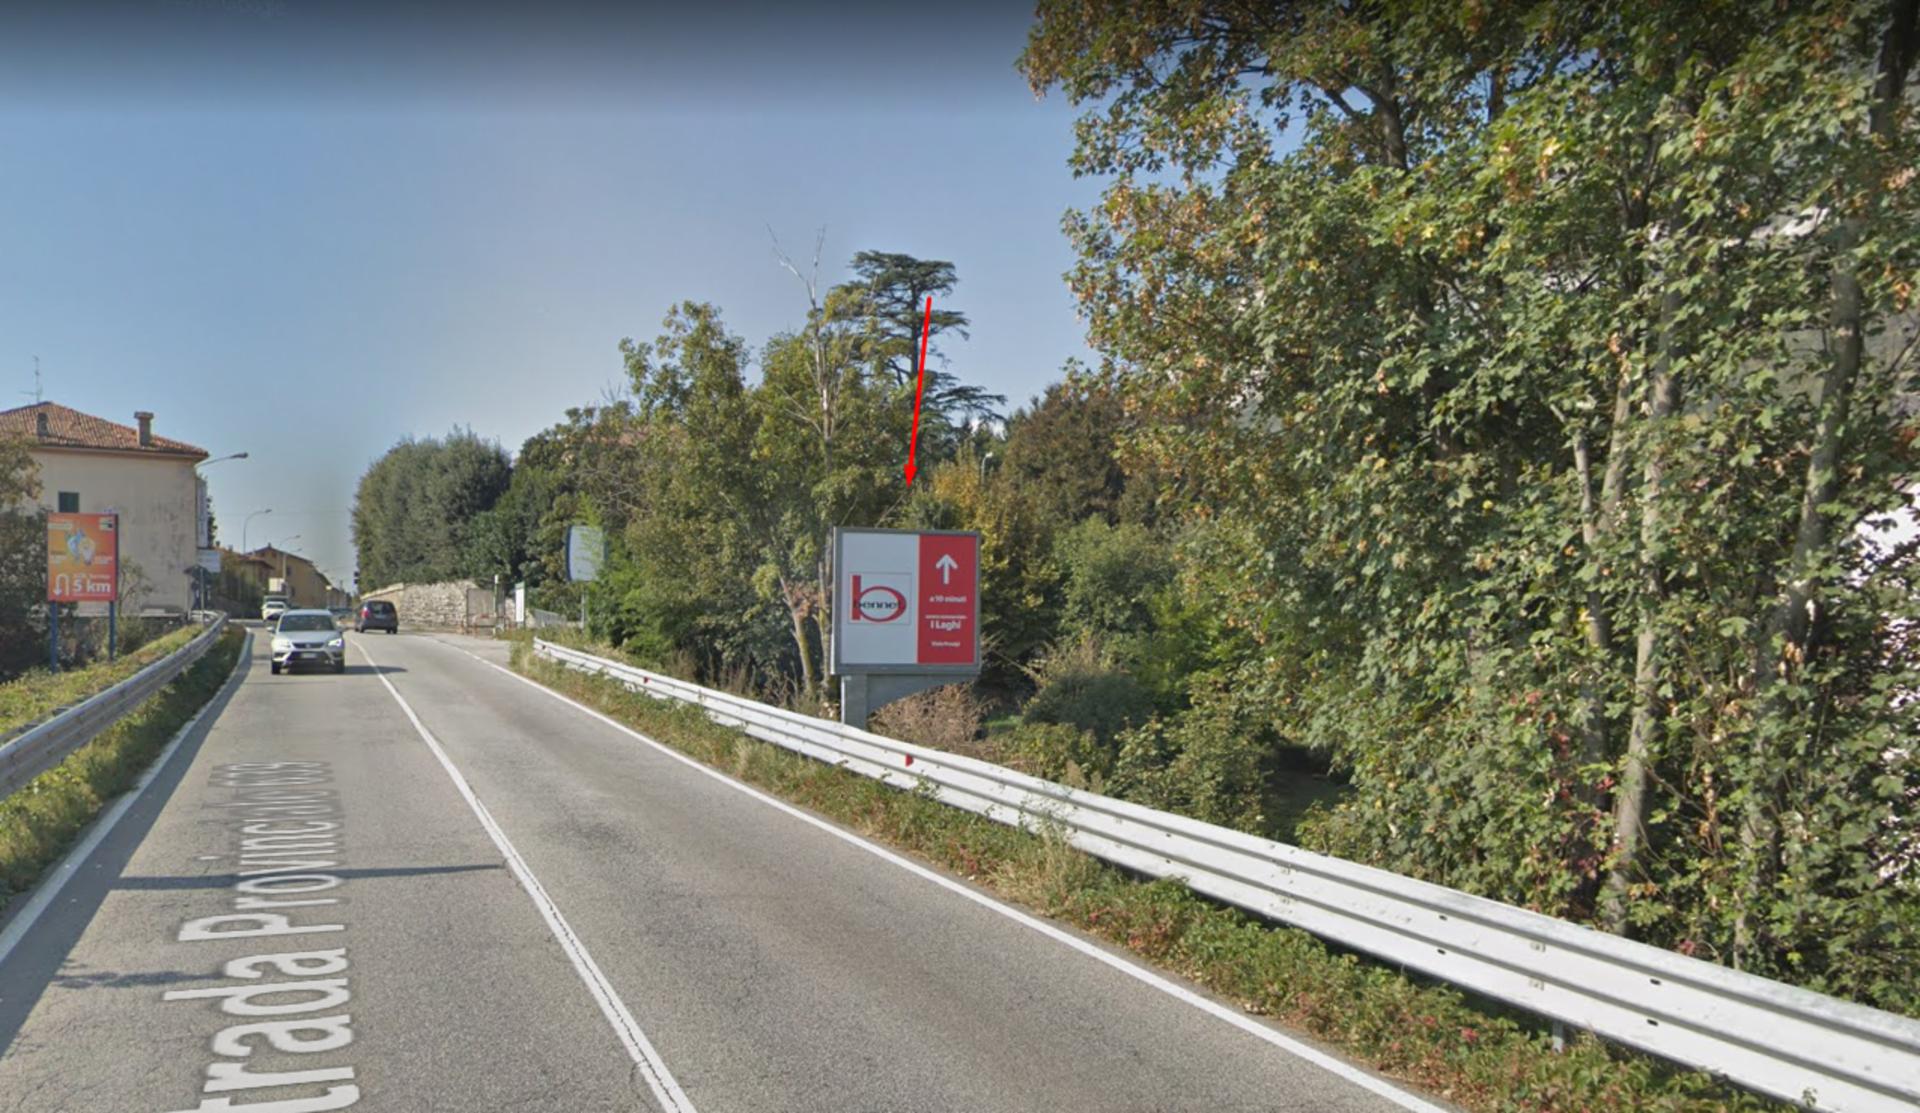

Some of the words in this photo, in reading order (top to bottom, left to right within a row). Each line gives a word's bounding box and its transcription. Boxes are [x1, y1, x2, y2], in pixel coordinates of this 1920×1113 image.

[72, 579, 83, 592] 5
[86, 579, 111, 592] km
[936, 620, 961, 631] Laghi
